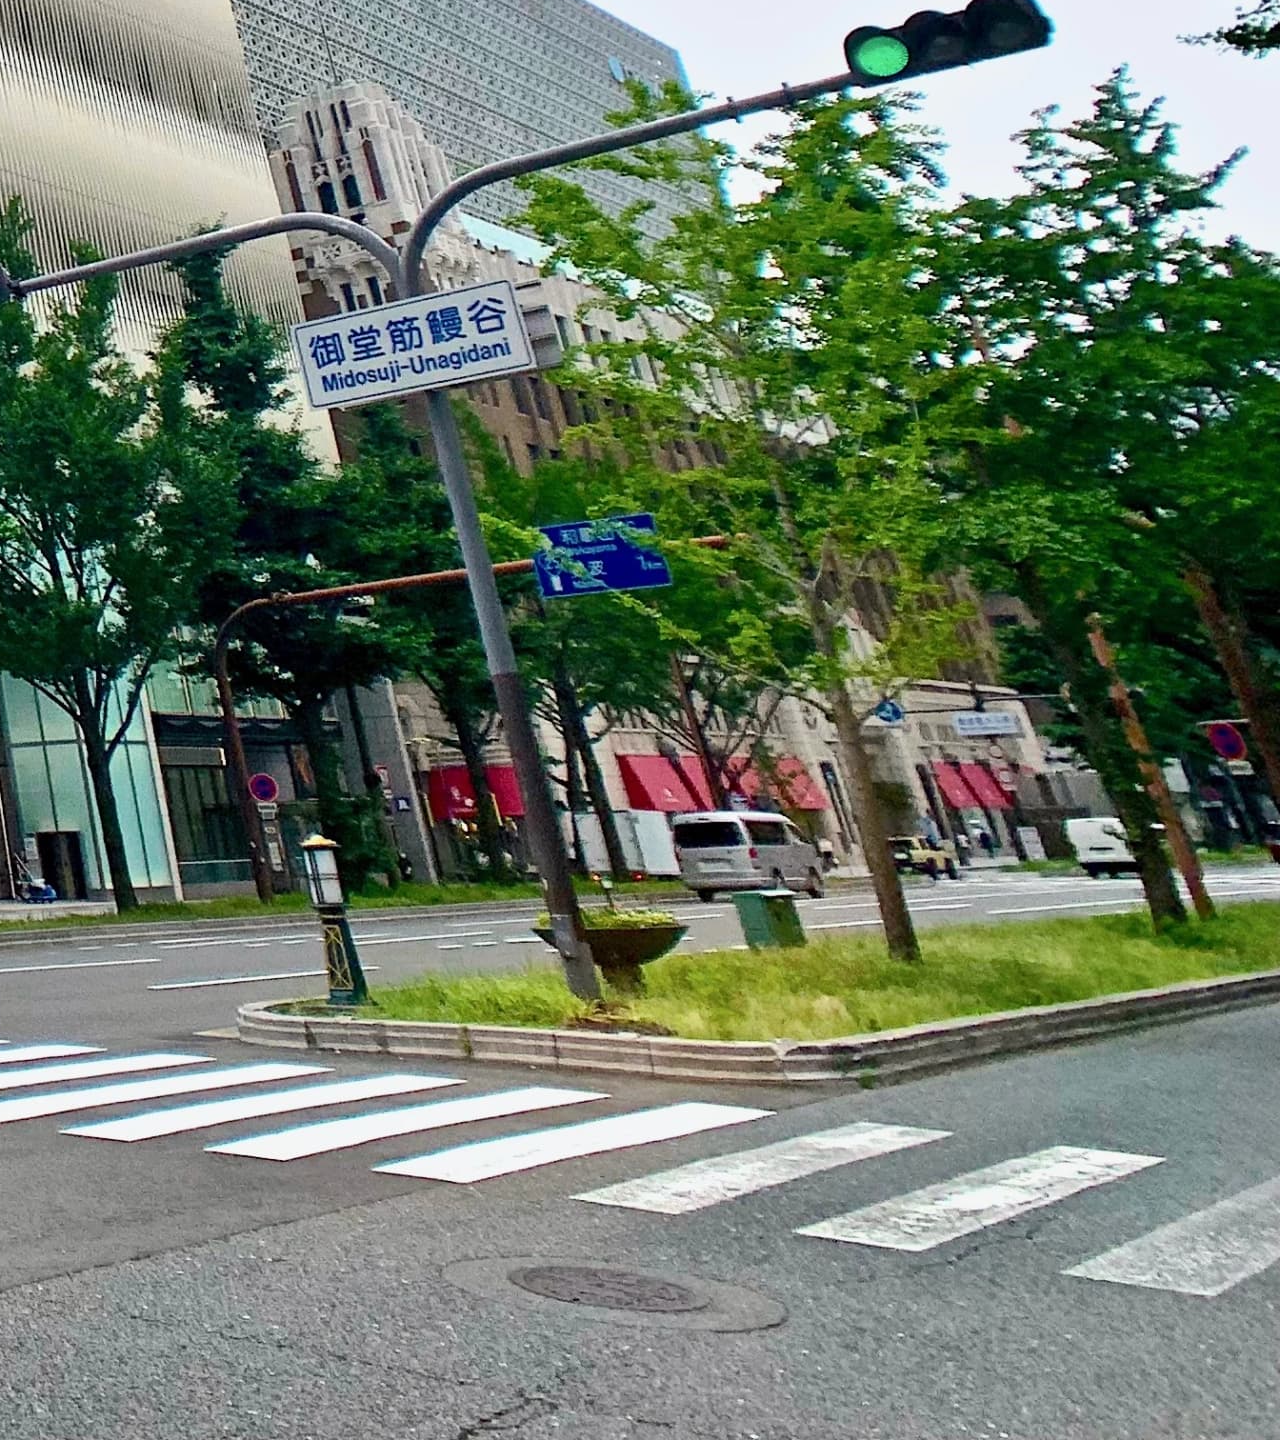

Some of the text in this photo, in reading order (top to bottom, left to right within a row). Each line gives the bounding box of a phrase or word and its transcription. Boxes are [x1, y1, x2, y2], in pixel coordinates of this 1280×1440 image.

[309, 297, 507, 369] 御堂筋鰻谷
[321, 337, 512, 392] Midosuji-Unagidani
